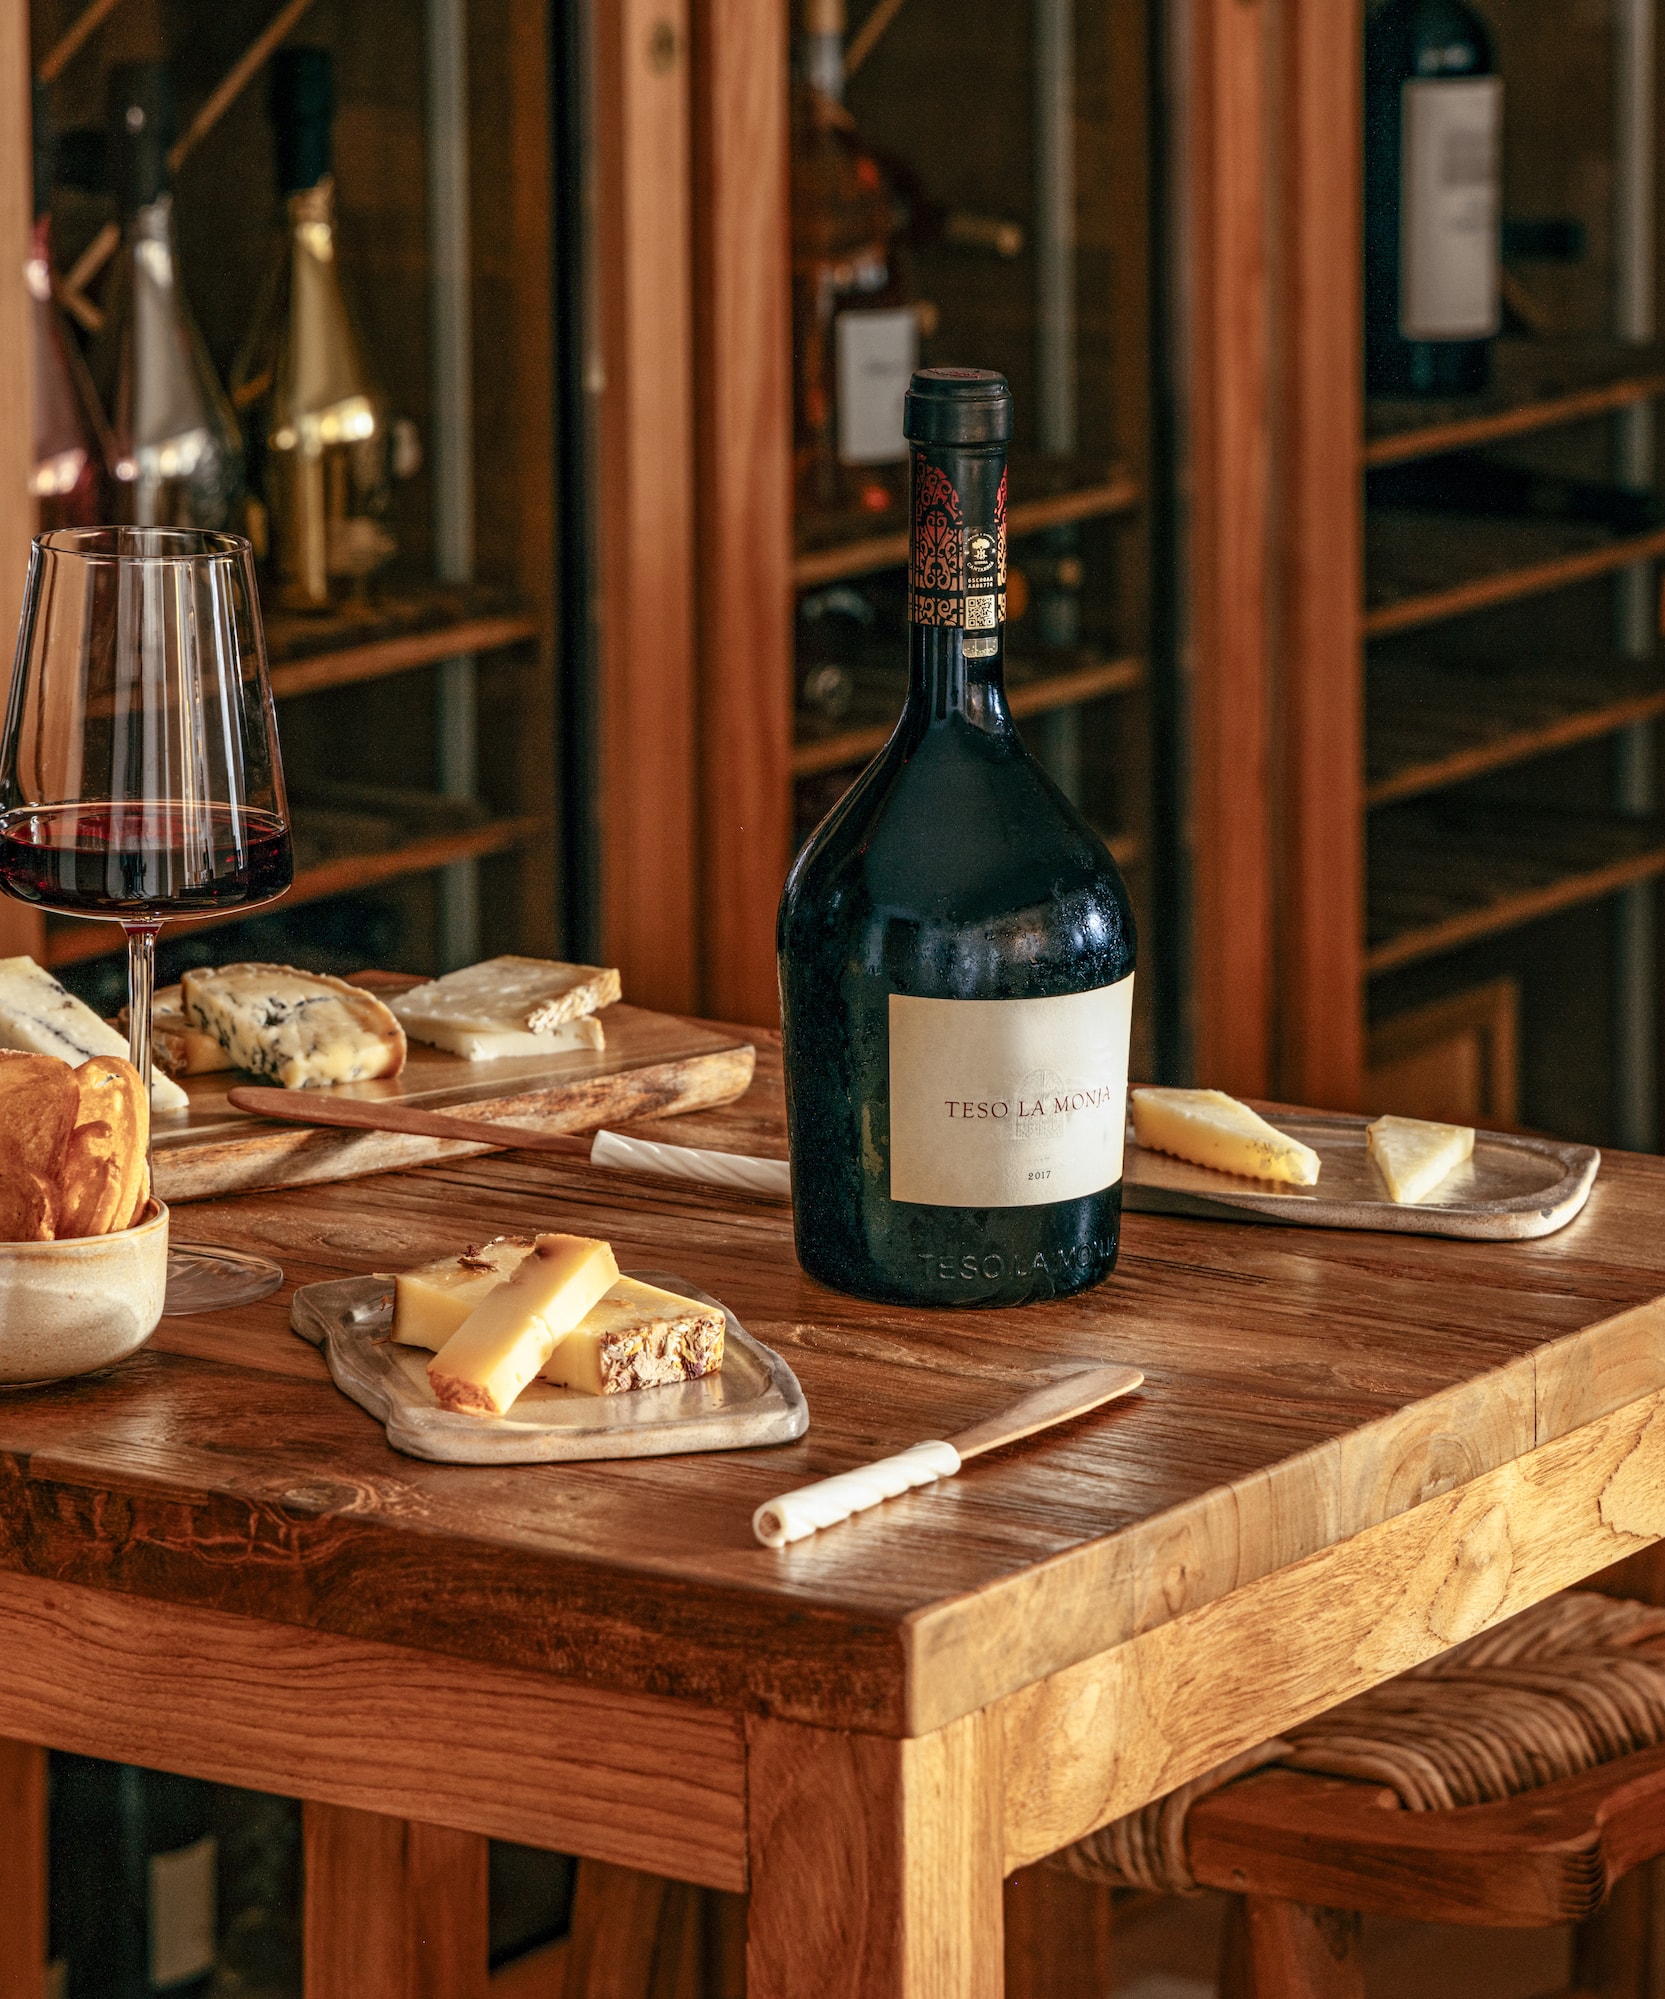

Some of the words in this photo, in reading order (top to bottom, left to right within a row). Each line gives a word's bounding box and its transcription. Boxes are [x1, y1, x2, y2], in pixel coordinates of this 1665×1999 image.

[945, 1101, 1008, 1119] TESO
[1018, 1100, 1045, 1117] LA
[1053, 1085, 1111, 1115] MONJA
[1027, 1170, 1052, 1181] 2017
[918, 1252, 1003, 1281] TESO
[1014, 1251, 1050, 1277] LA
